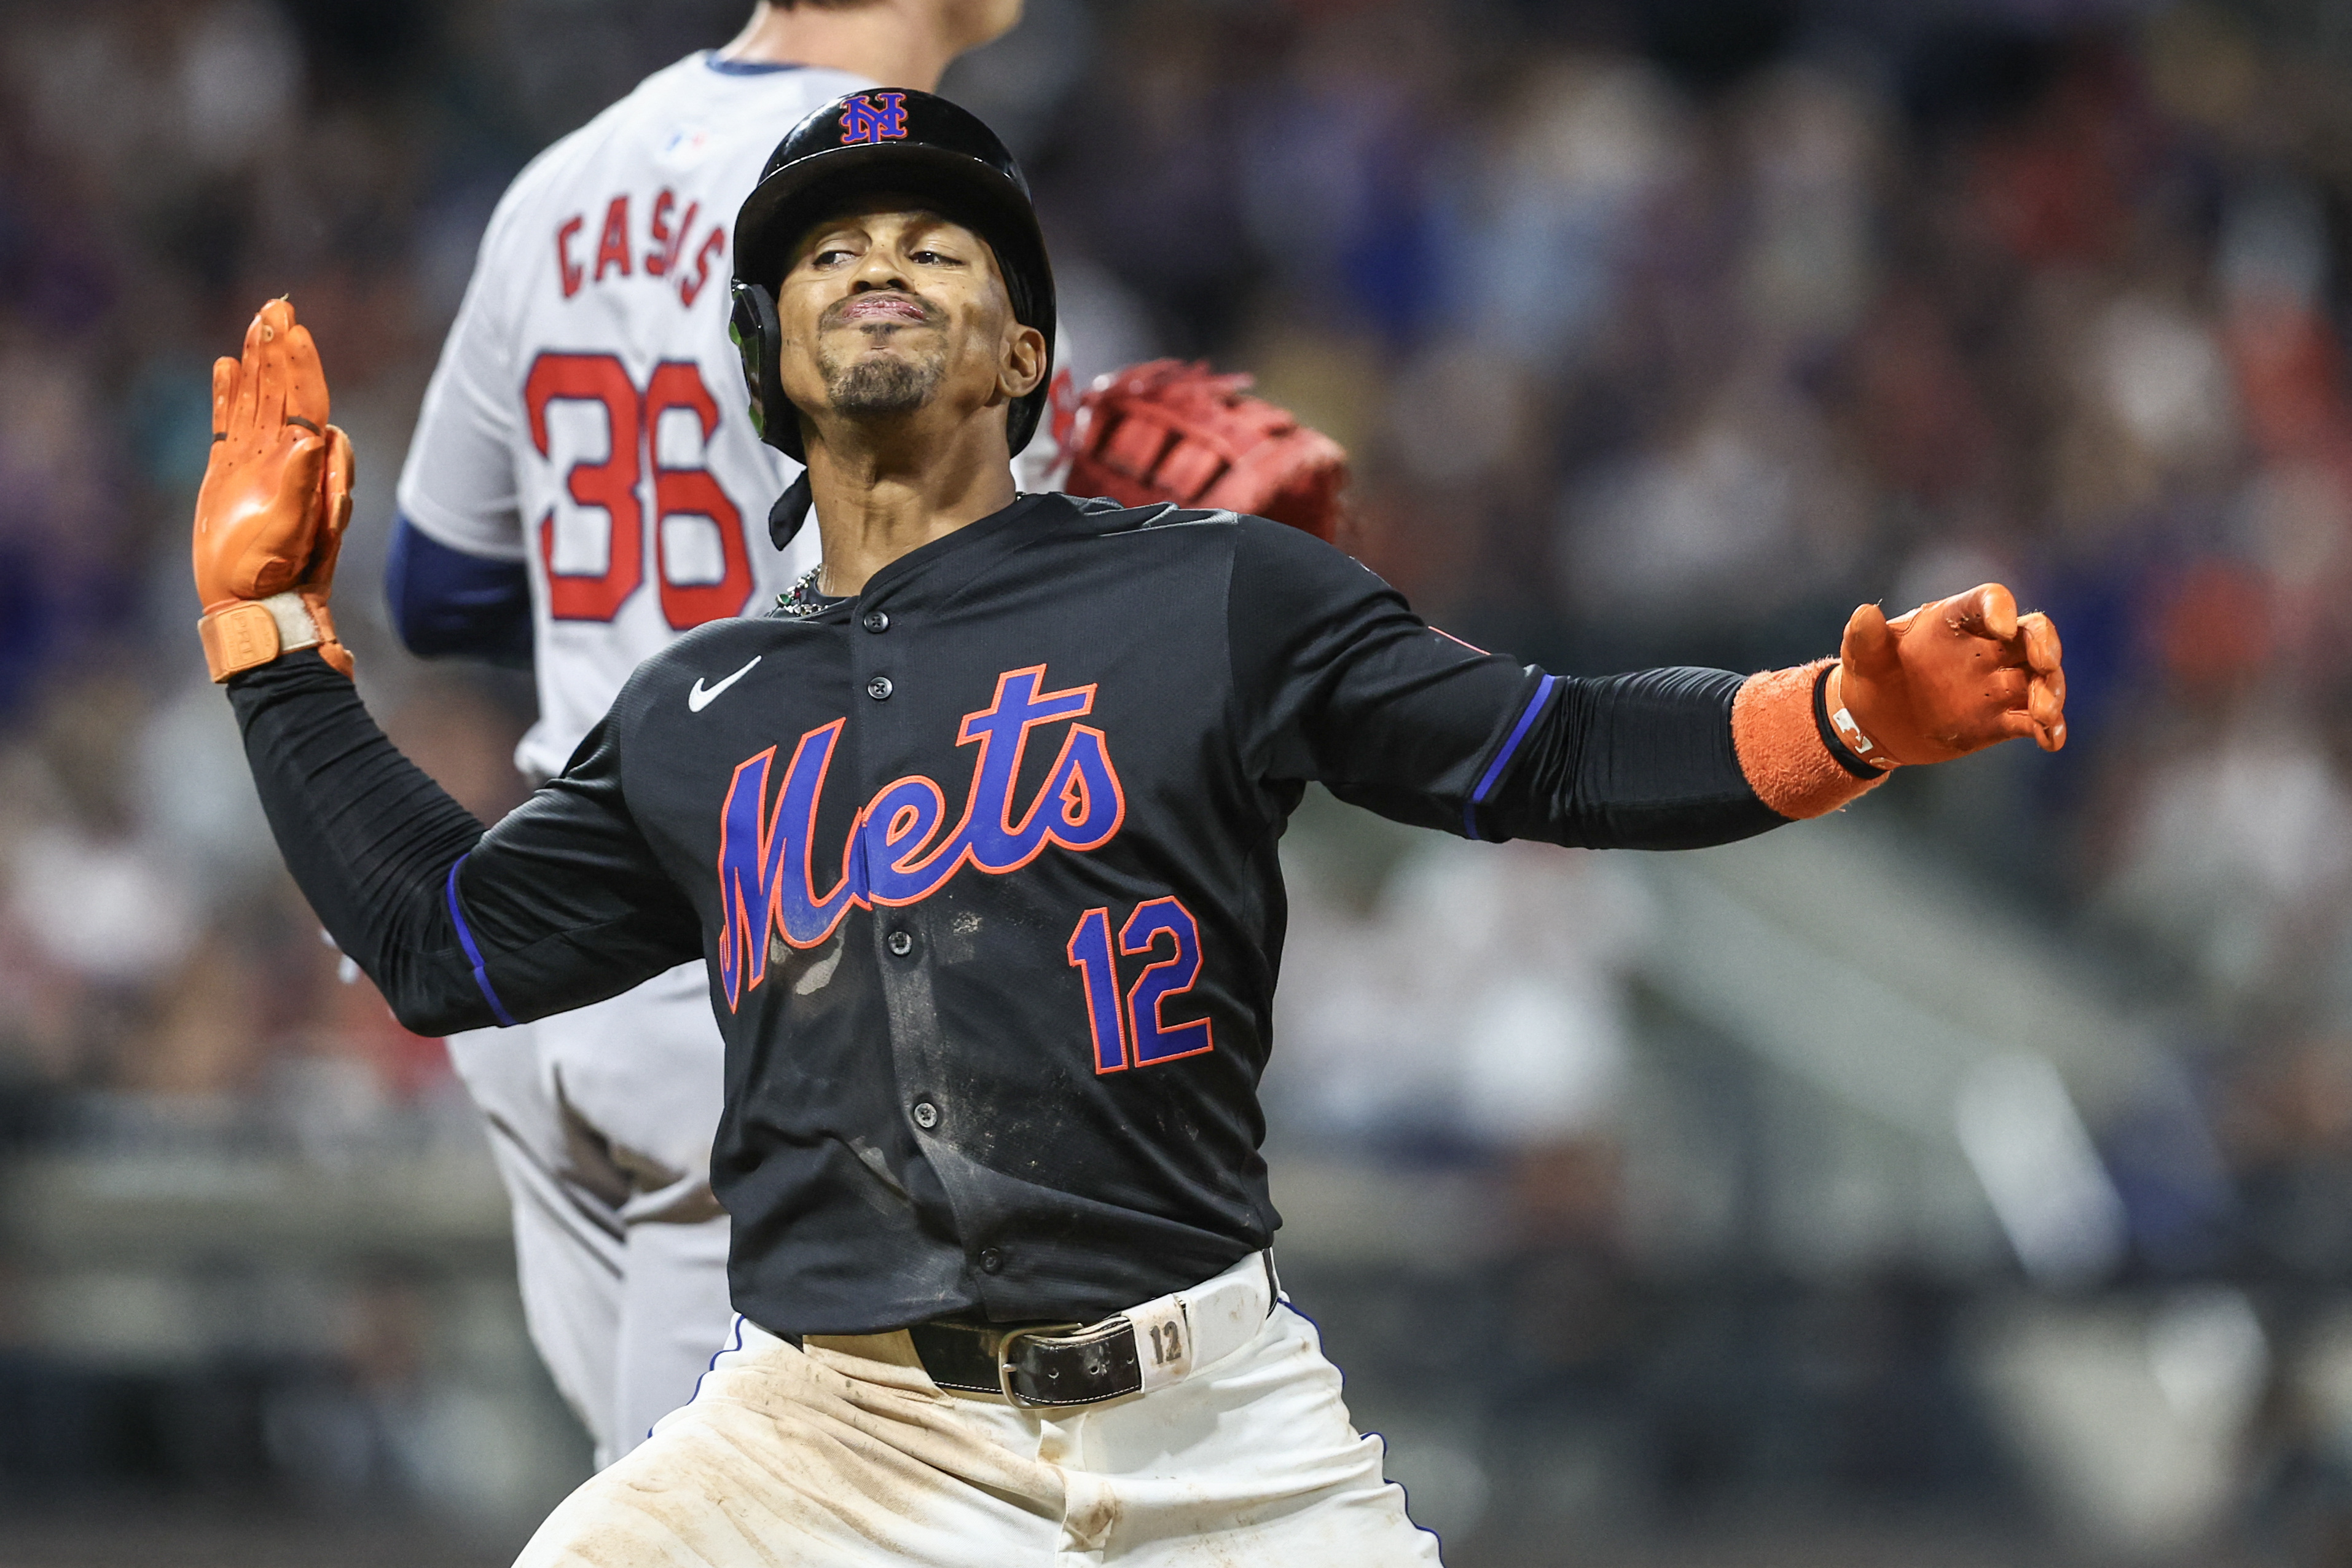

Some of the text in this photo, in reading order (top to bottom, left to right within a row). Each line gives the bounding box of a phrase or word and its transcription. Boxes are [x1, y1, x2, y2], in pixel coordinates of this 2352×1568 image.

[839, 92, 908, 144] NY
[524, 351, 756, 630] 36
[718, 664, 1125, 1014] Mets
[1067, 896, 1213, 1075] 12
[1150, 1321, 1182, 1364] 12
